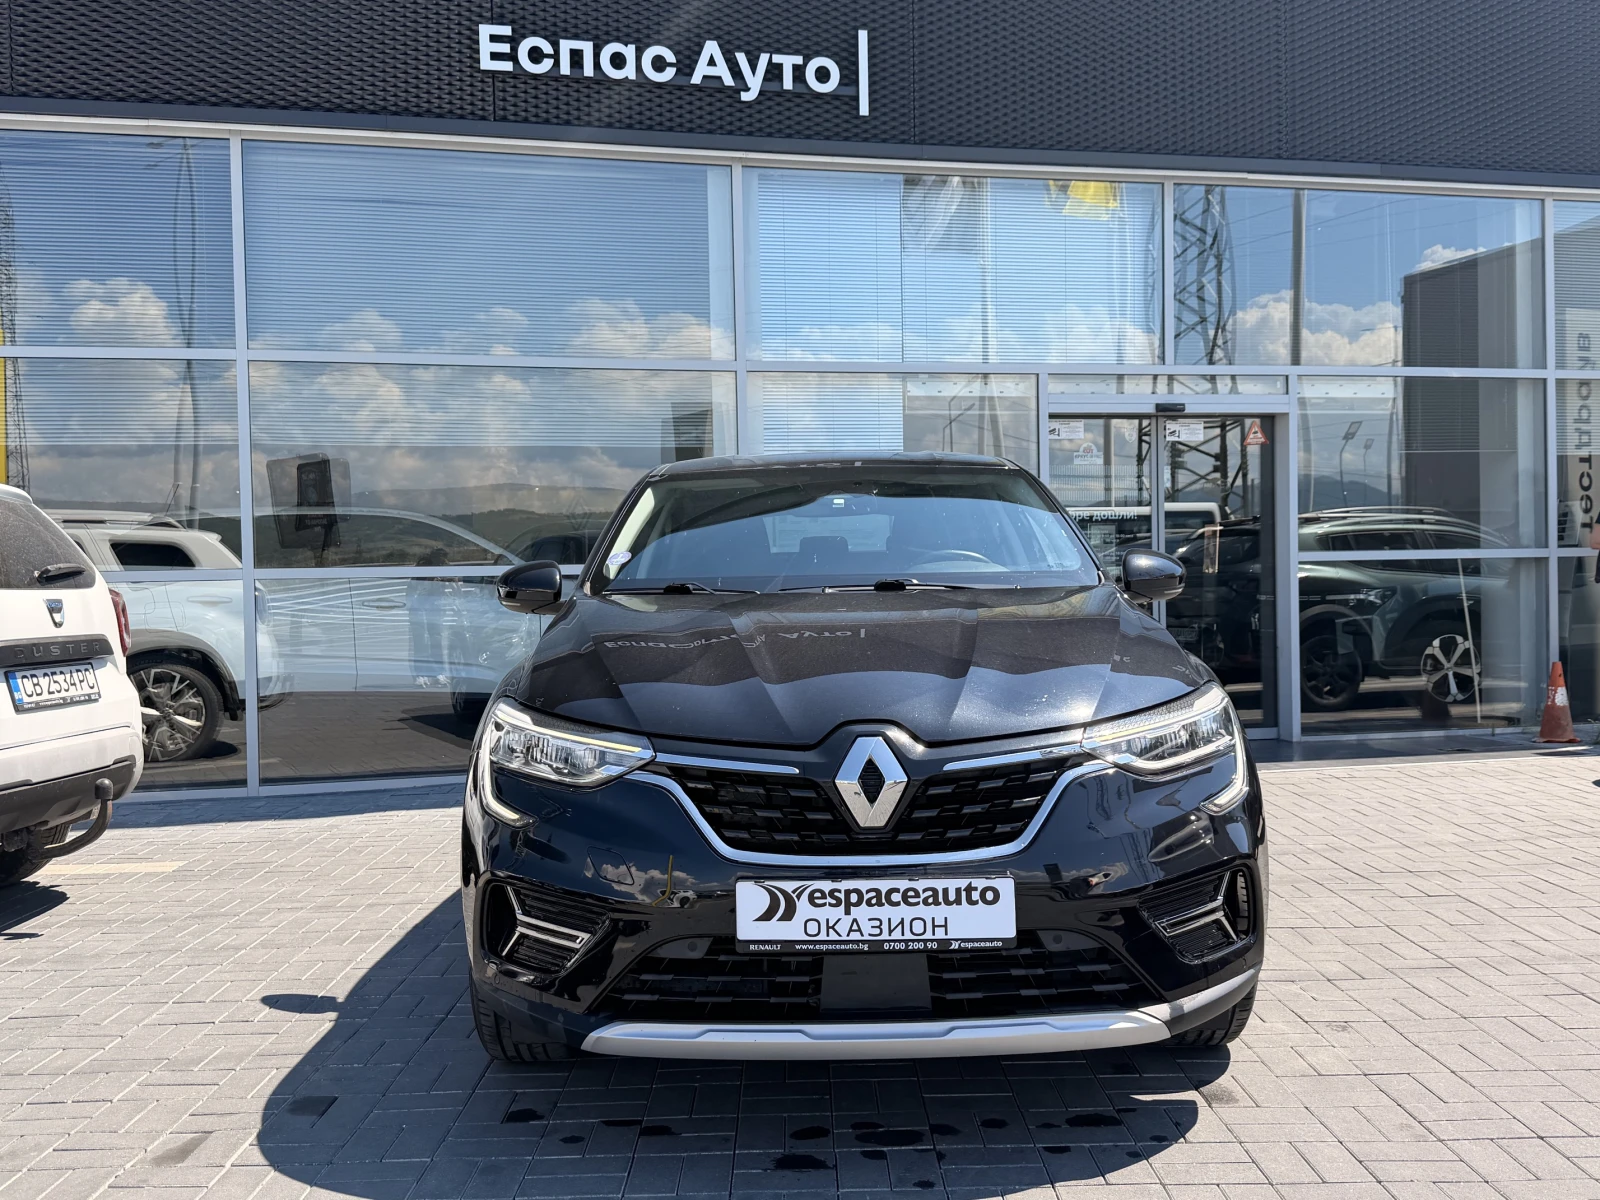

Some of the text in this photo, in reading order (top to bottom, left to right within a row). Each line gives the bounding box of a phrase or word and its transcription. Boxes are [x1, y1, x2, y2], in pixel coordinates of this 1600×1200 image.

[478, 23, 841, 102] Еспас Ауто
[1092, 509, 1138, 522] дошли!
[14, 641, 101, 658] DUSTER
[43, 669, 78, 695] 2534
[807, 881, 1001, 916] espaceauto
[803, 916, 949, 938] ОКАЗИОН
[749, 940, 1003, 951] RENAULT www.espaceauto.bg 0700 200 90 espaceauto
